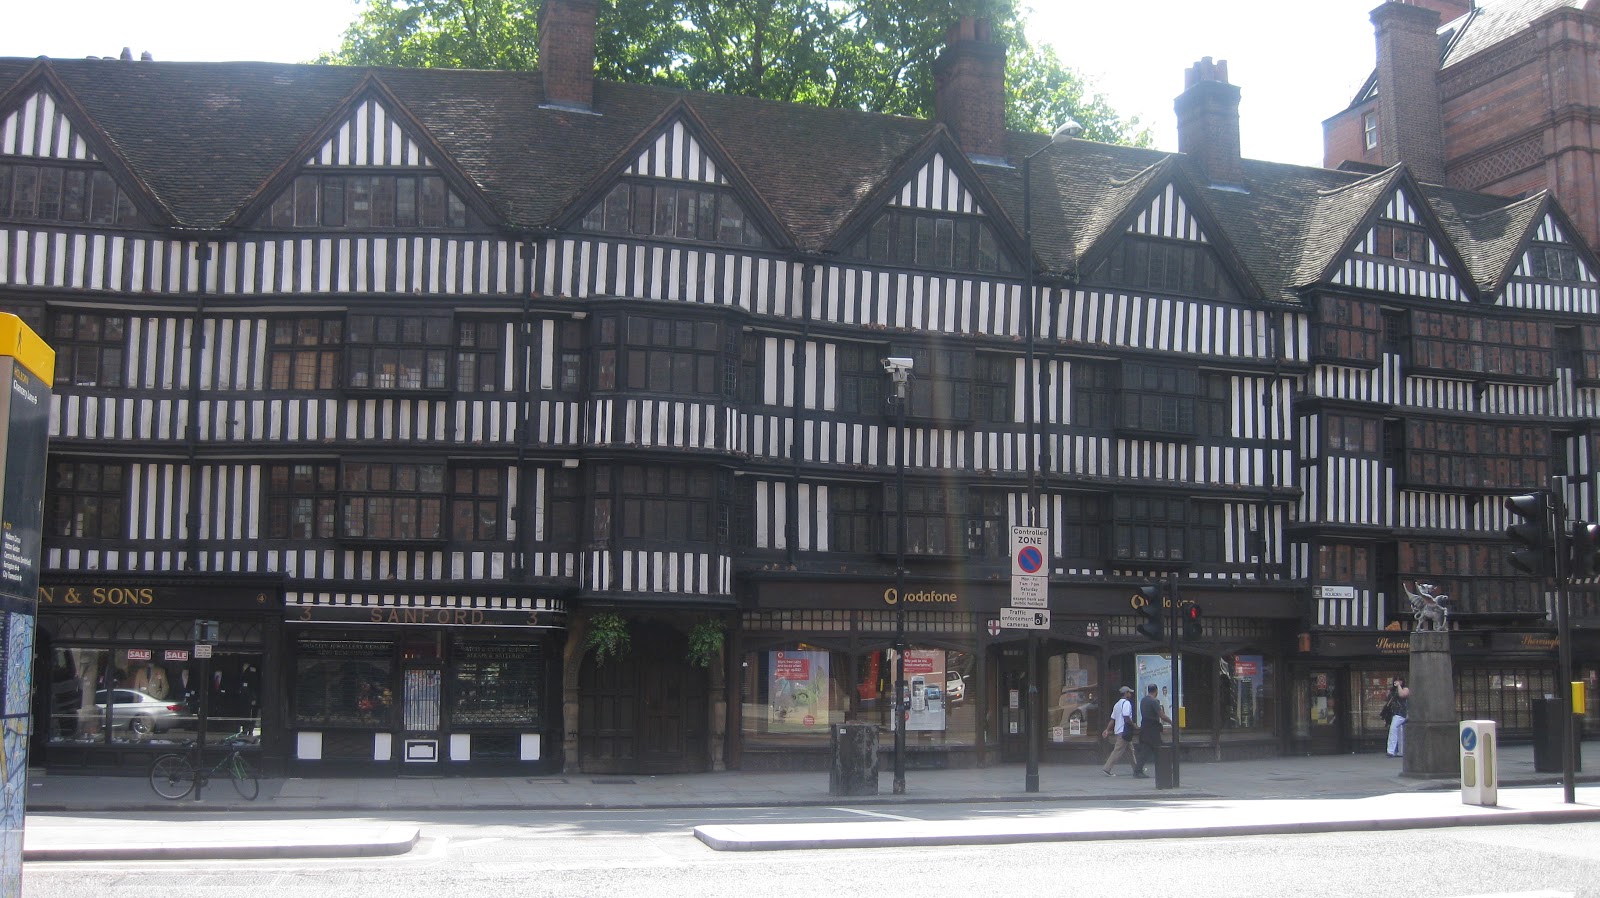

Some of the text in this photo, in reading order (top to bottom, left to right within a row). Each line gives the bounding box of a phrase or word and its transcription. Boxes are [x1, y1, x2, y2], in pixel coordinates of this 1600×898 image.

[1018, 536, 1042, 544] ZONE
[64, 588, 82, 604] &
[93, 588, 153, 604] SONS
[300, 606, 538, 626] 3 SANFORD 3
[1376, 638, 1411, 649] Shervin
